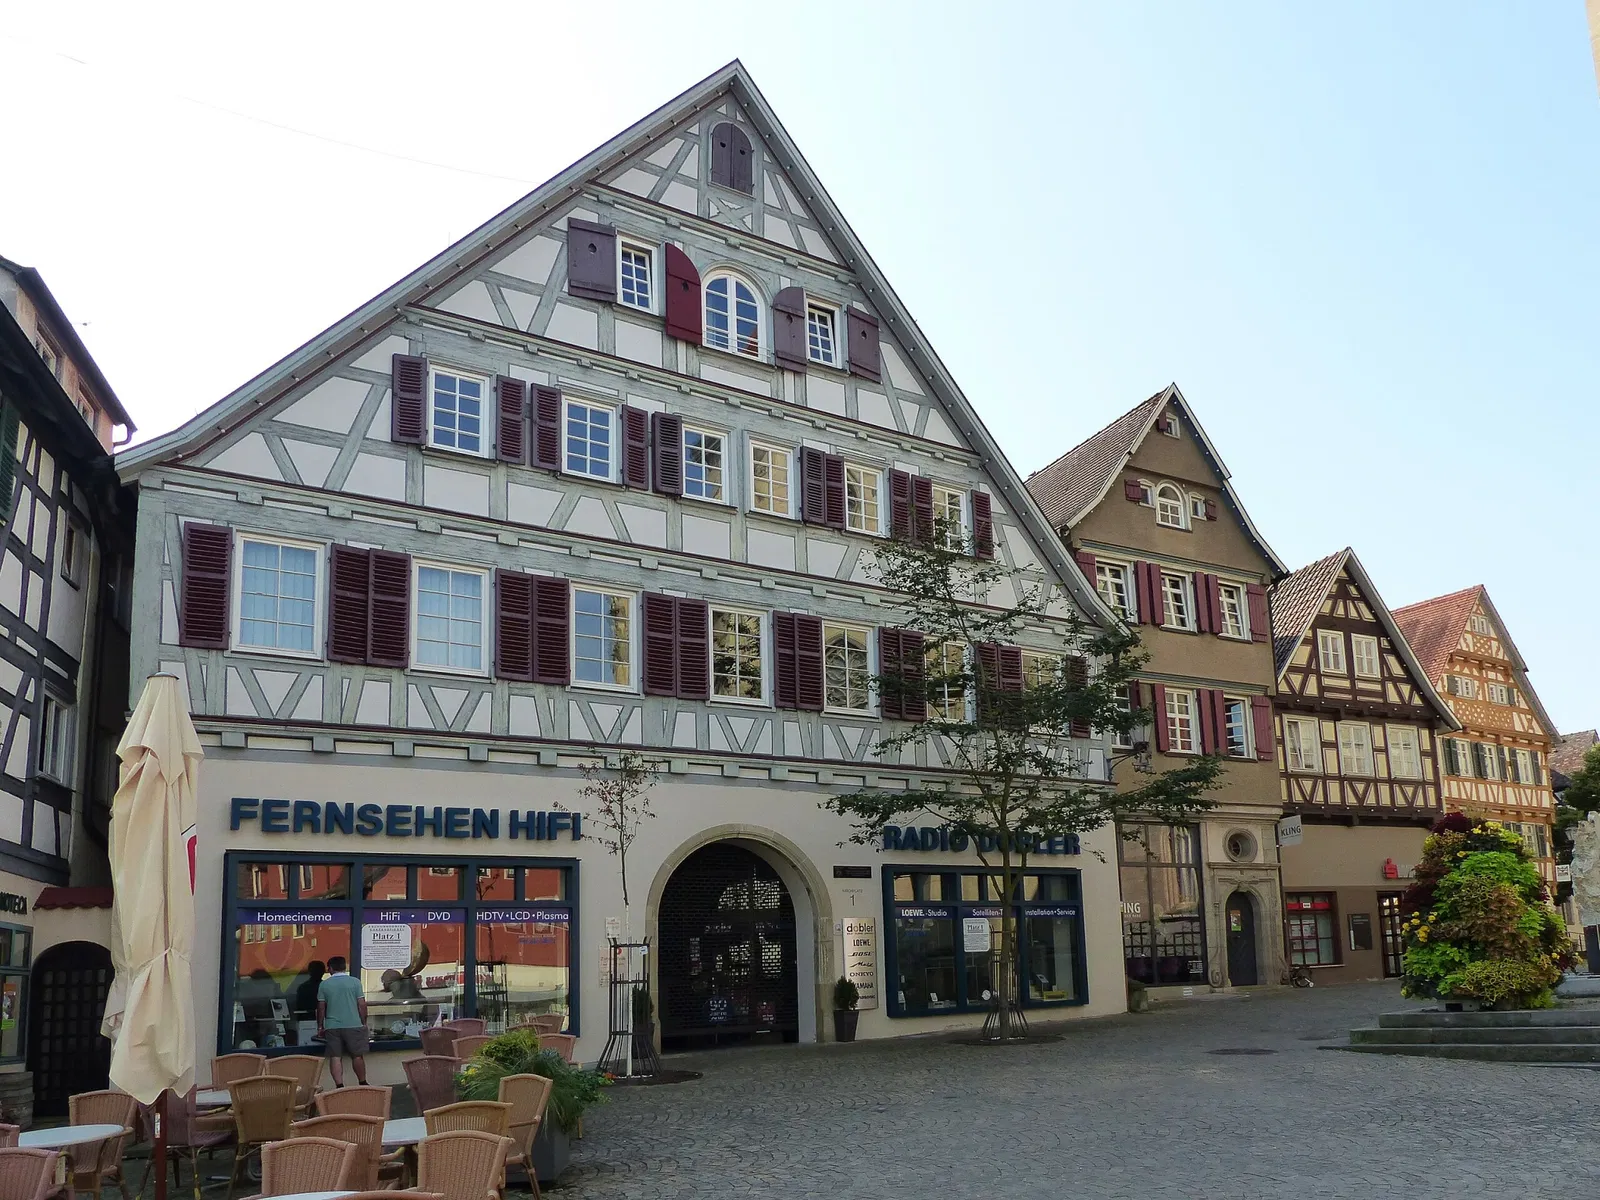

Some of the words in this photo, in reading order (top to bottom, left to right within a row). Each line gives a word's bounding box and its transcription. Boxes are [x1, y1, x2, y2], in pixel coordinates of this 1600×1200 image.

[230, 797, 499, 839] FERNSEHEN
[509, 809, 581, 841] HIFI
[1280, 825, 1302, 837] KLING
[883, 825, 969, 852] RADIO
[849, 894, 855, 906] 1
[257, 911, 332, 922] Homecinema
[380, 911, 401, 921] HiFi
[427, 911, 451, 921] DVD
[846, 923, 874, 932] dobler
[372, 932, 394, 940] Platz
